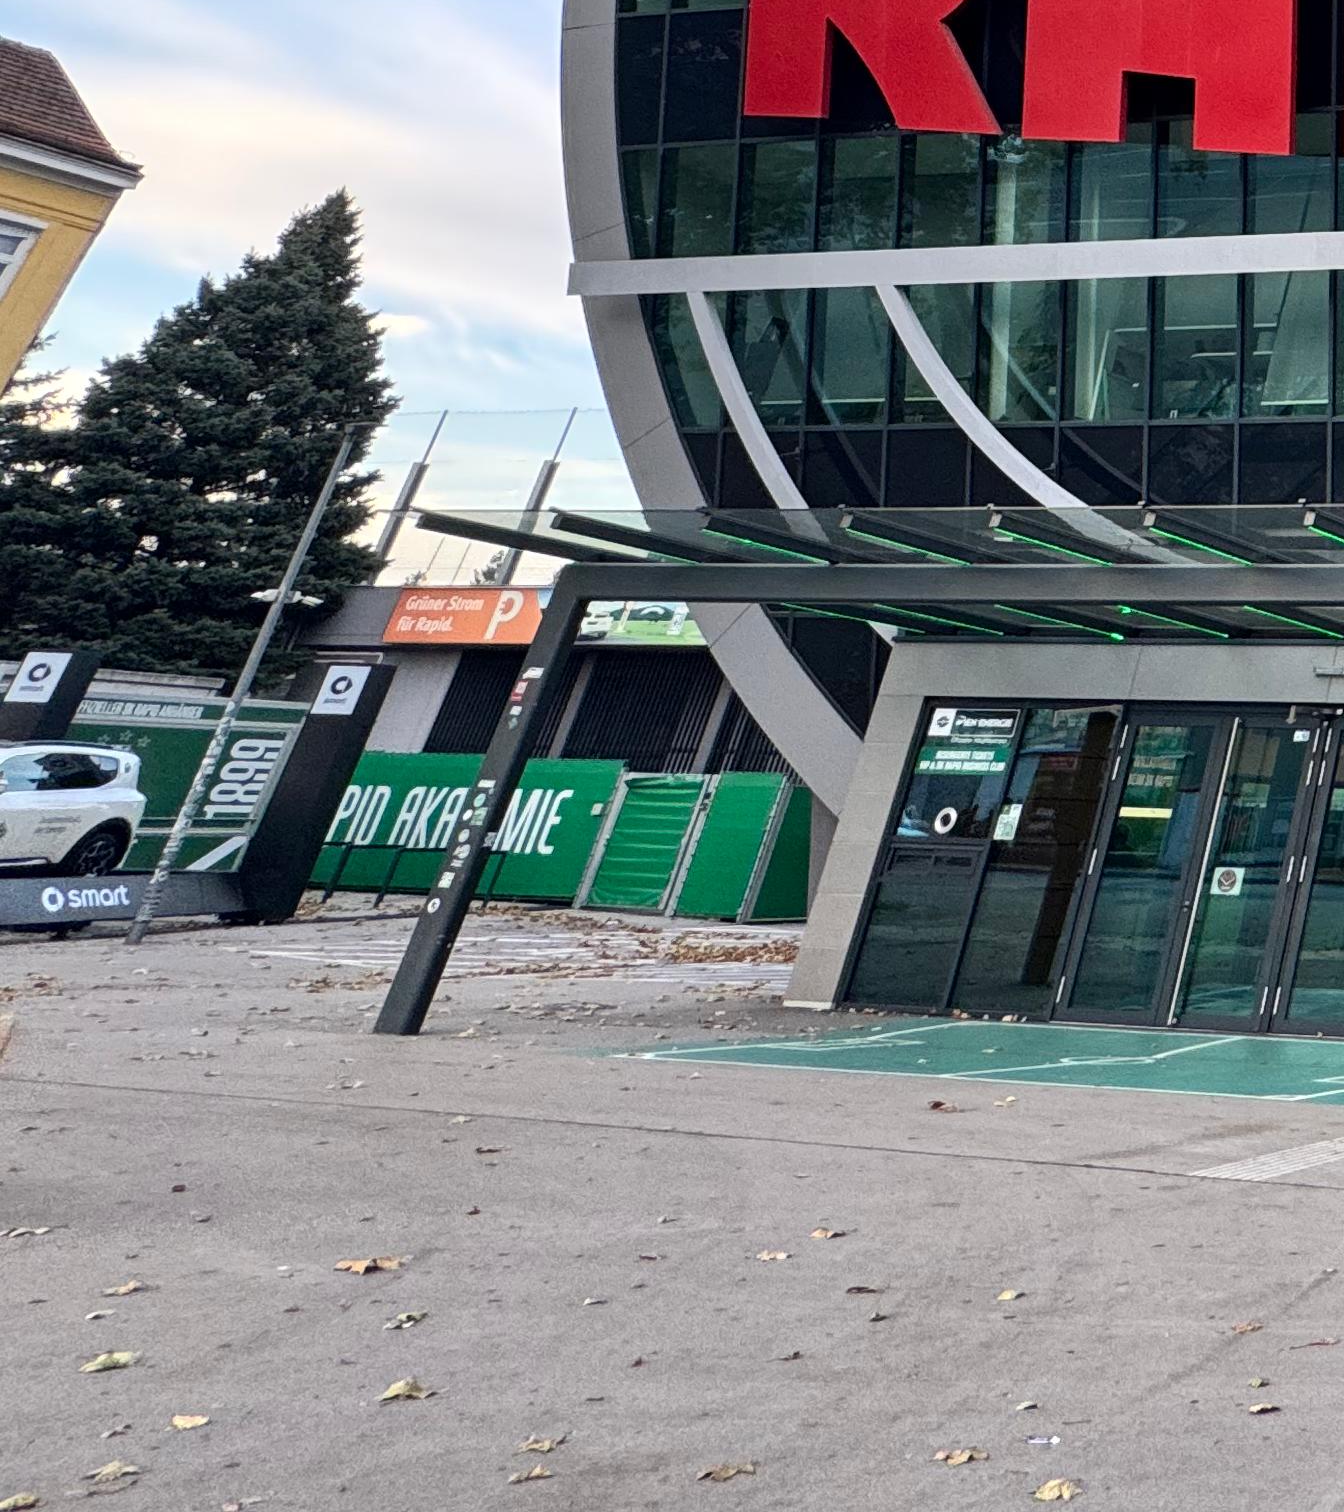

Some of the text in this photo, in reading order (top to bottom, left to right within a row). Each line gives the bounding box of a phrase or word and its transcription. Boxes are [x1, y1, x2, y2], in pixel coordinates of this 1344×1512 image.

[406, 594, 484, 611] Grüner Strom
[396, 616, 453, 634] für Rapid.
[203, 738, 285, 820] 1899
[324, 784, 574, 855] PID AKAMIE
[67, 885, 131, 908] smart
